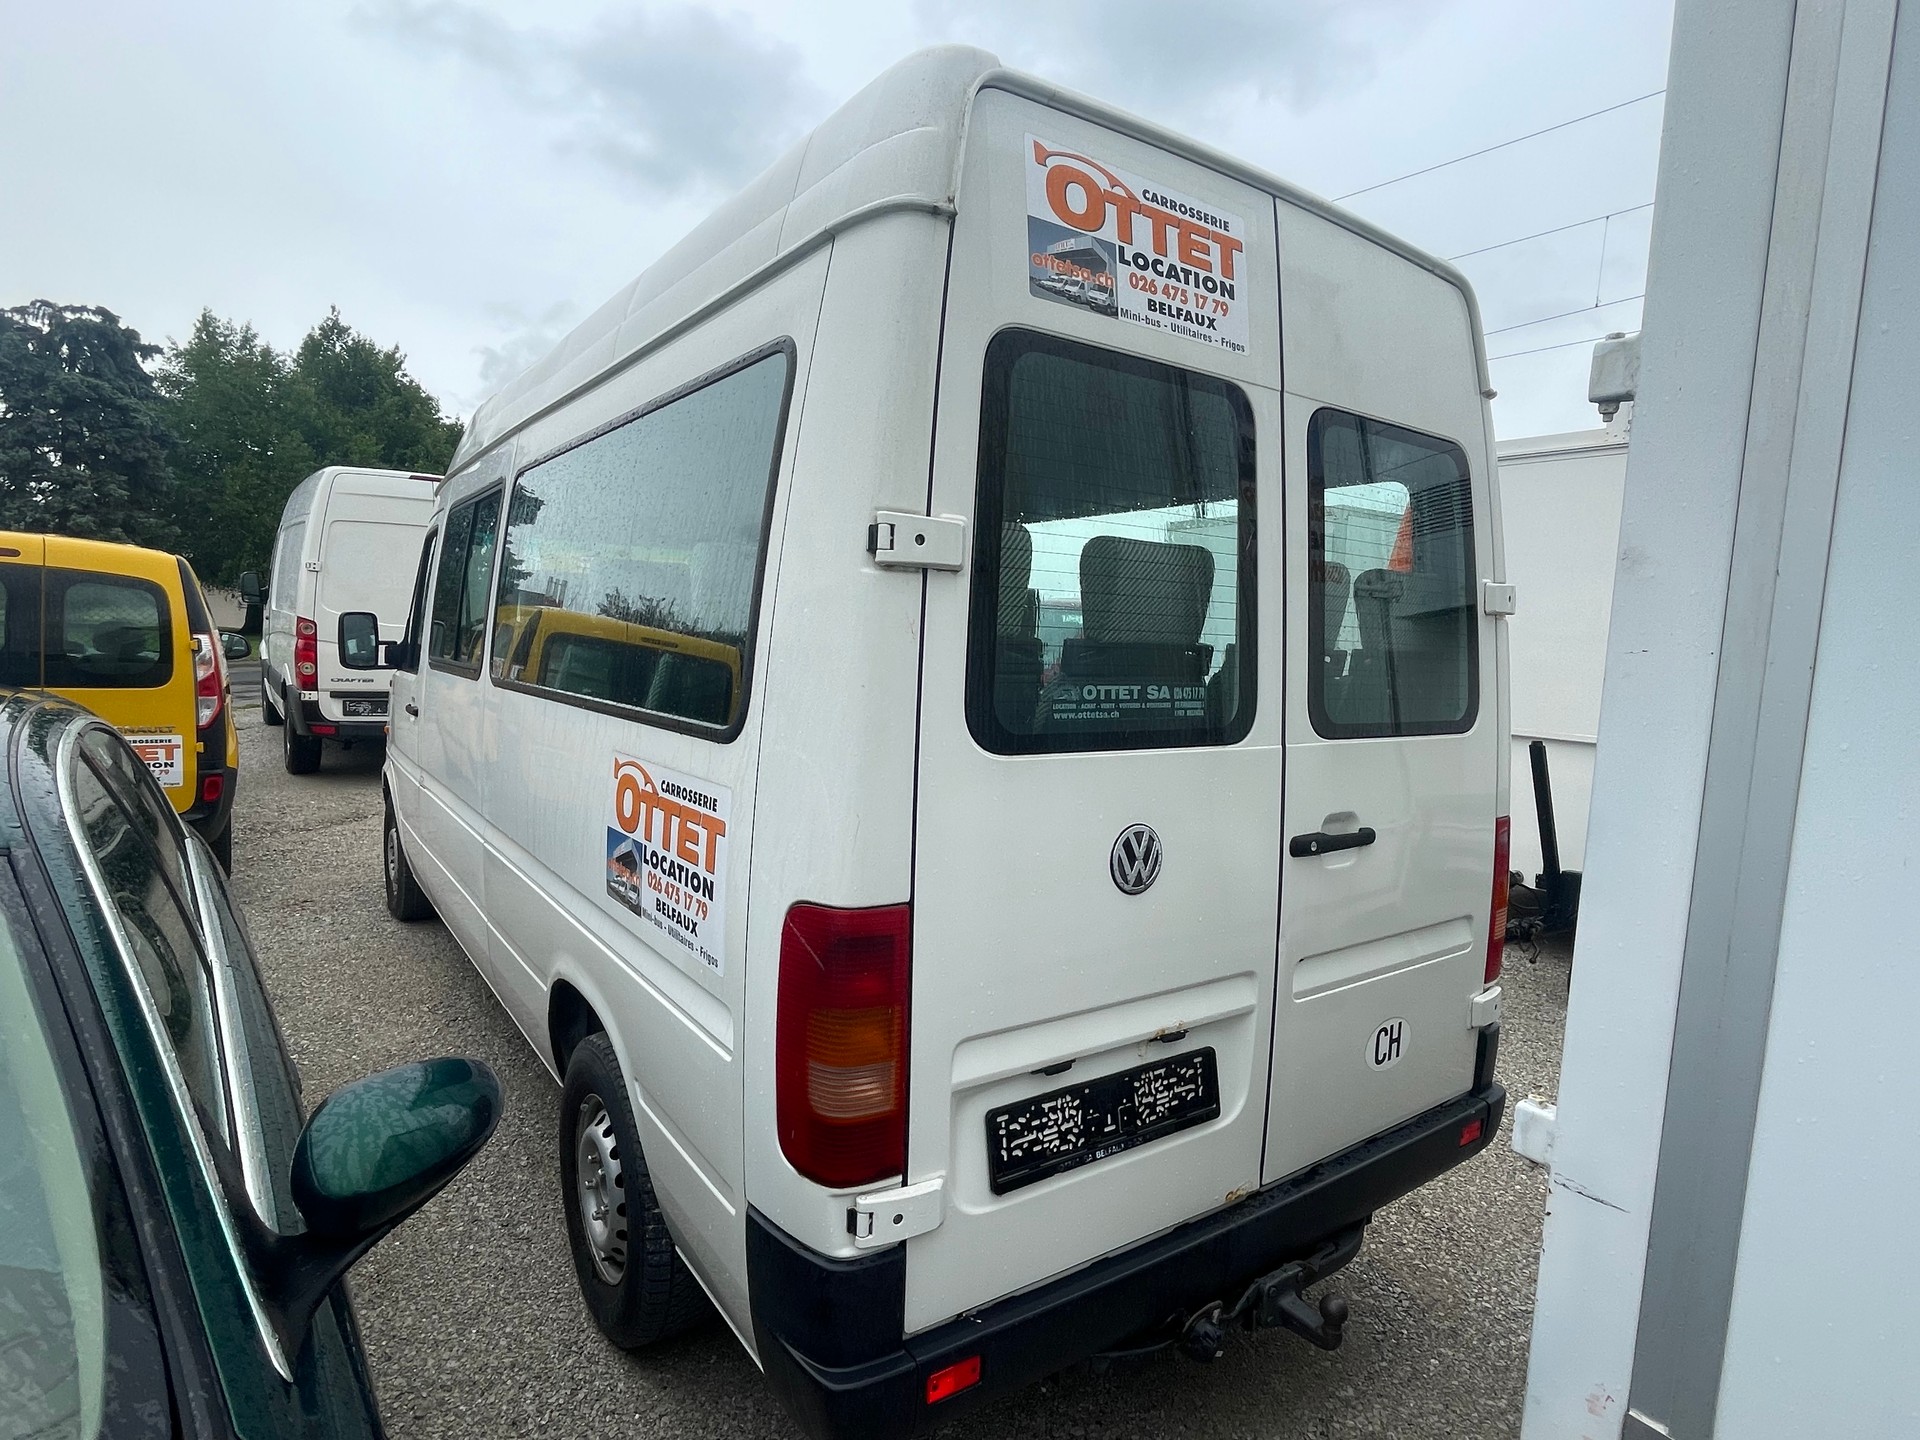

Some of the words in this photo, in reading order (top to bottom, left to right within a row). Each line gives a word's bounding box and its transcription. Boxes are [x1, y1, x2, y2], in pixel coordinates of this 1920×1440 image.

[1045, 163, 1244, 282] OTTET
[1141, 188, 1231, 233] CARROSSERIE
[1031, 252, 1115, 288] ottetsa.ch
[1117, 244, 1236, 301] LOCATION
[1128, 271, 1158, 295] 026
[1161, 283, 1189, 305] 475
[1193, 292, 1209, 311] 17
[1212, 298, 1230, 317] 79
[1146, 297, 1218, 332] BELFAUX
[1120, 307, 1162, 329] Mini-bus
[1170, 322, 1213, 344] Utilitaires
[1221, 336, 1246, 354] Frigos
[1082, 684, 1142, 700] OTTET
[1146, 685, 1171, 700] SA
[117, 726, 176, 734] ENAULT
[1053, 711, 1120, 719] www.ottetsa.ch
[660, 779, 719, 813] CARROSSERIE
[615, 772, 727, 876] OTTET
[642, 844, 715, 902] LOCATION
[647, 869, 663, 895] 026
[664, 882, 681, 906] 475
[683, 892, 694, 910] 17
[695, 898, 709, 921] 79
[655, 896, 699, 938] BELFAUX
[699, 945, 719, 968] Frigos
[1374, 1020, 1402, 1066] CH
